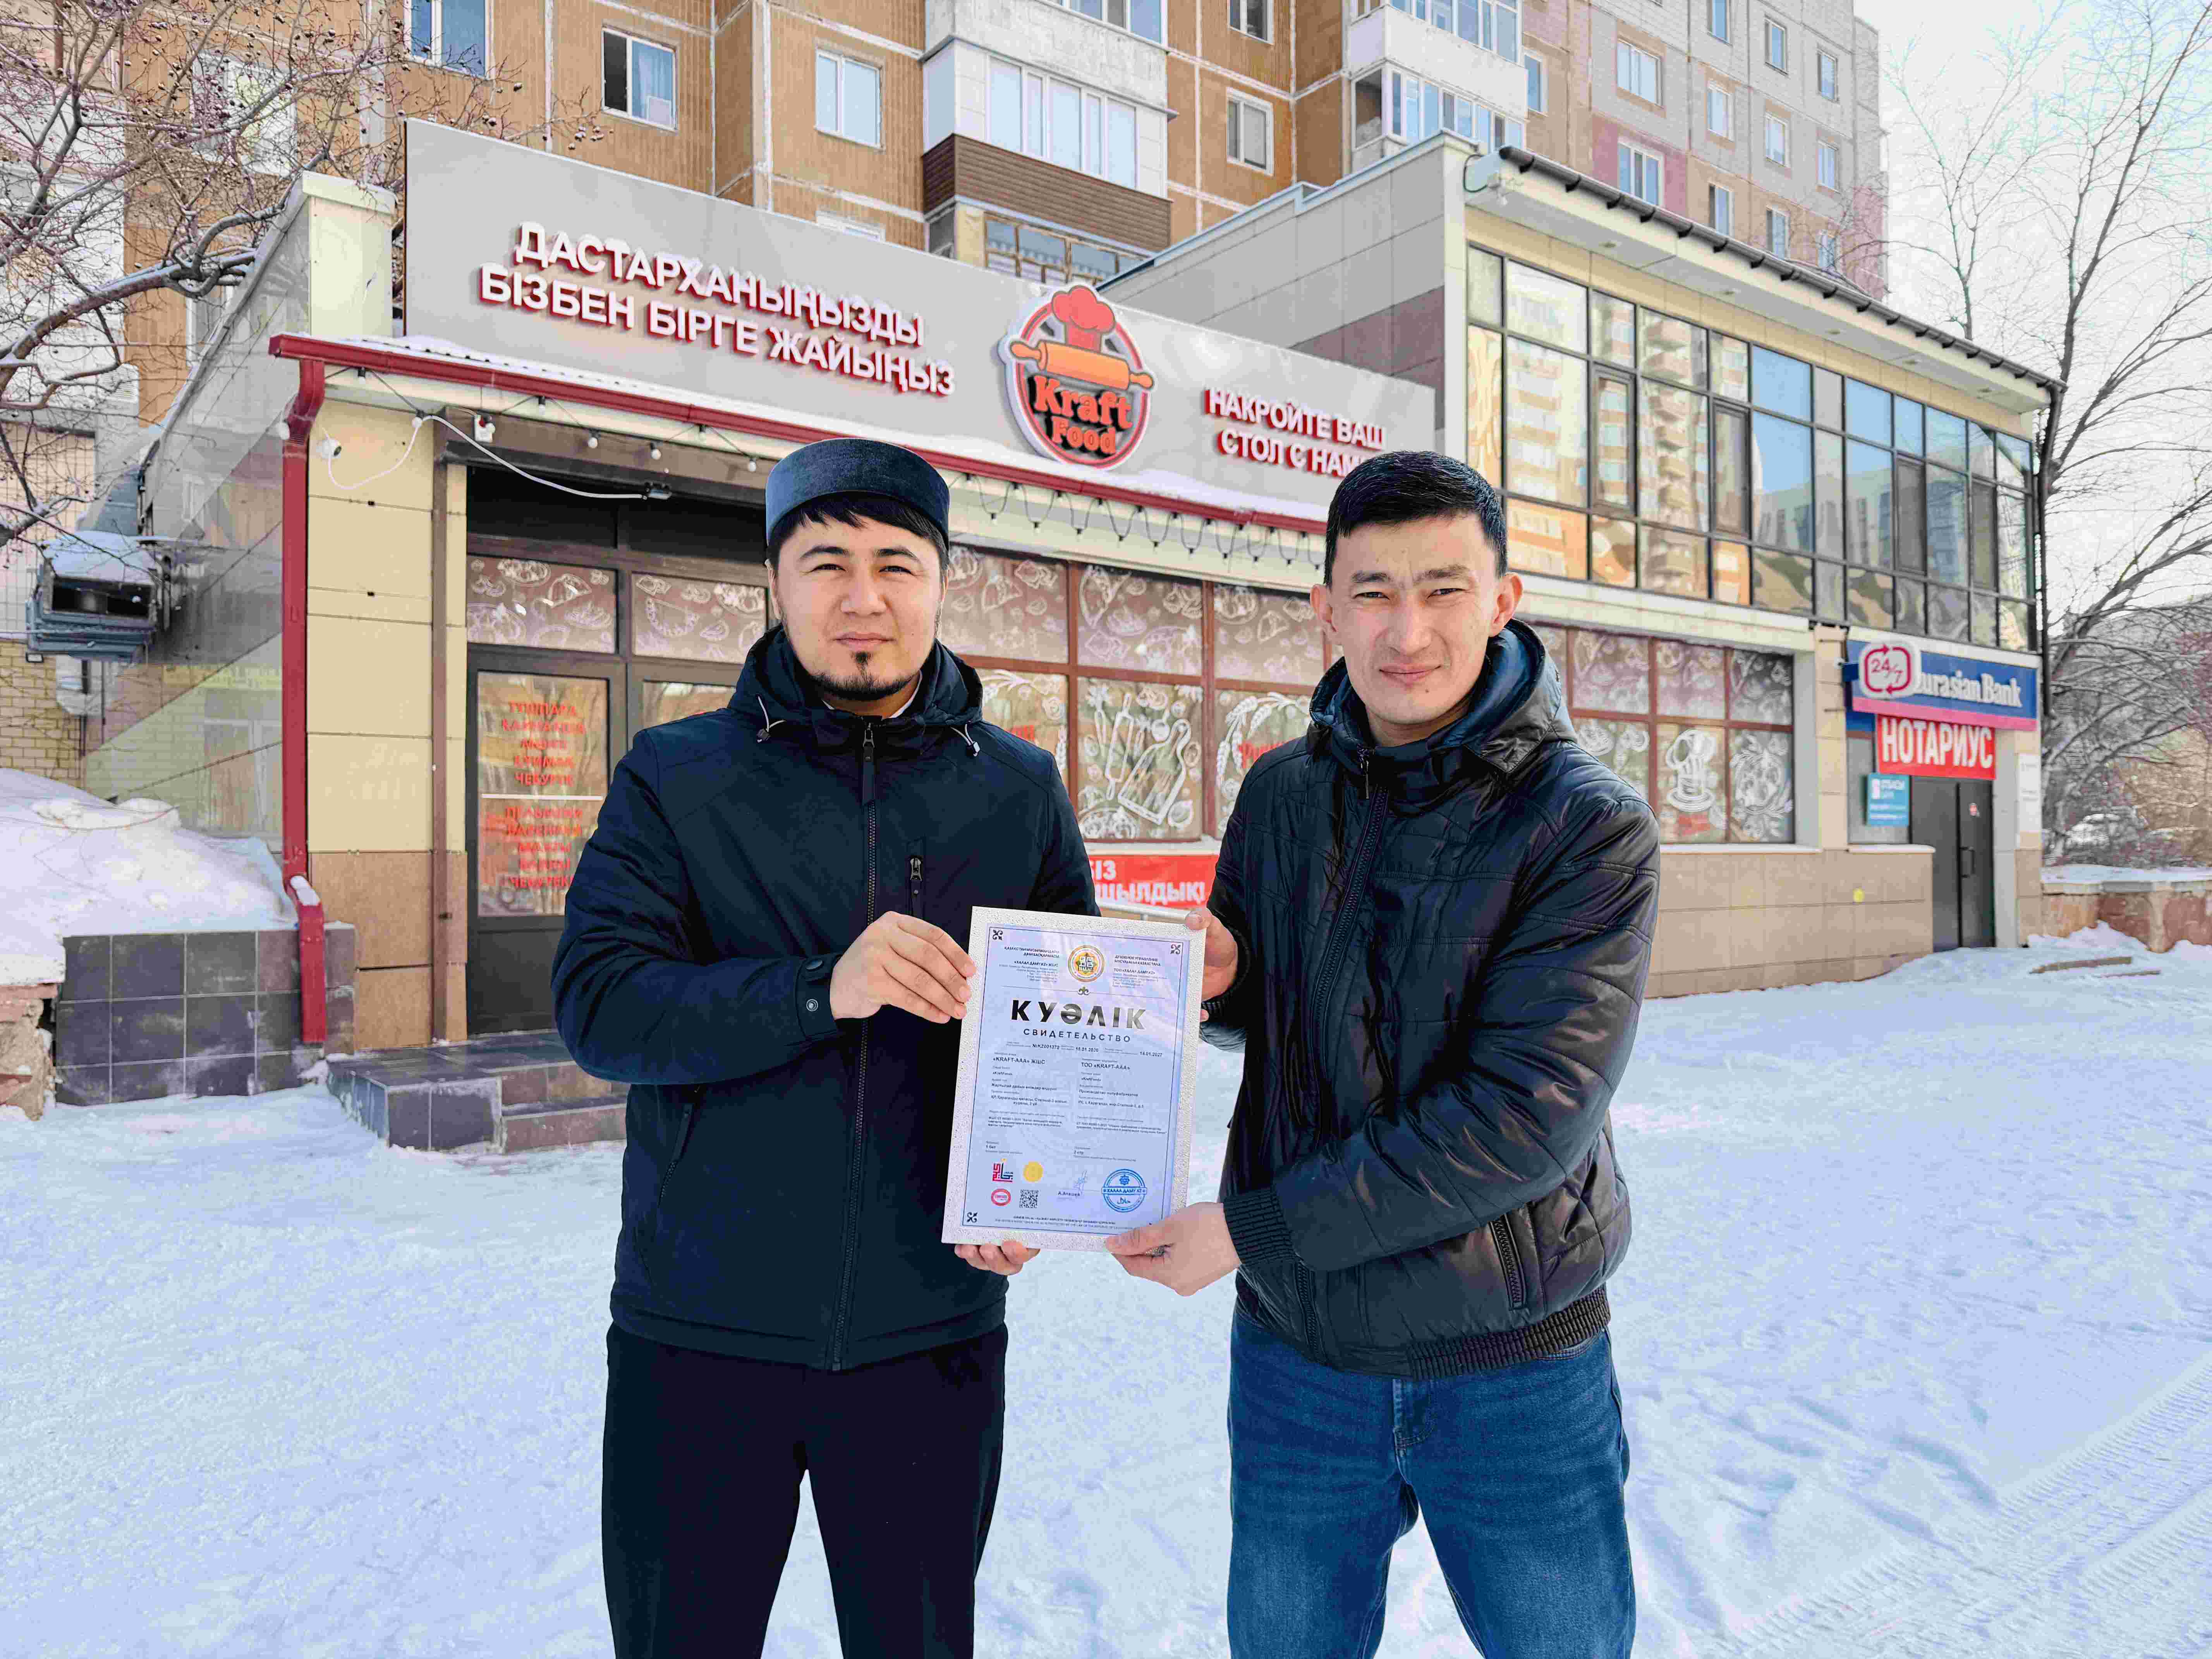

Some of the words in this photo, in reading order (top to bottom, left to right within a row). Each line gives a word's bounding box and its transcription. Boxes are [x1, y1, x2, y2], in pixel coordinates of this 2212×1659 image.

[514, 221, 924, 347] ДАСТАРХАНЫҢЫЗДЫ
[480, 262, 635, 329] БІЗБЕН
[649, 300, 759, 356] БІРГЕ
[766, 326, 955, 396] ЖАЙЫҢЫЗ
[1032, 375, 1133, 429] Kraft
[1204, 386, 1332, 440] НАКРОЙТЕ
[1333, 415, 1387, 450] ВАШ
[1050, 415, 1116, 455] Food
[1217, 428, 1285, 465] СТОЛ
[1286, 443, 1307, 468] С
[1307, 446, 1364, 477] НАМ
[1915, 670, 1981, 703] urasian
[1980, 673, 2023, 708] Bank
[1882, 718, 1994, 769] НОТАРИУС
[1096, 881, 1206, 905] ШЫЛДЫҚ
[1011, 1000, 1146, 1029] КУӘЛІК
[1023, 1029, 1130, 1042] СВИДЕТЕЛЬСТВО
